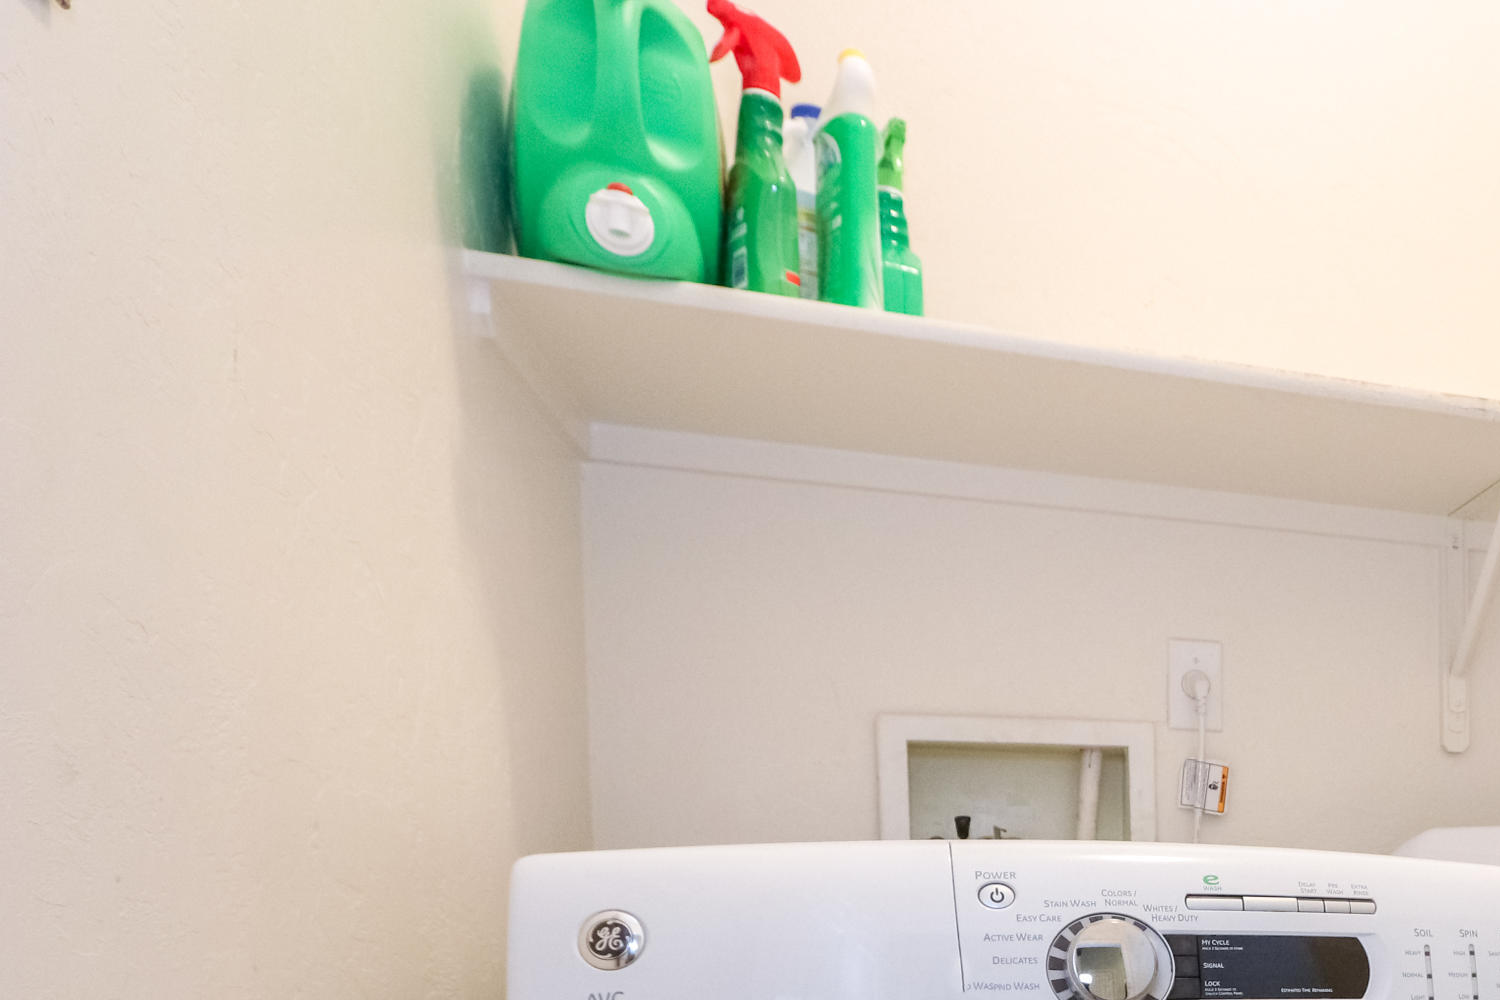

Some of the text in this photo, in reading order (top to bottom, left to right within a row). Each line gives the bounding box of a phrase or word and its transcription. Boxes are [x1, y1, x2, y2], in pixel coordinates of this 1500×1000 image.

[975, 871, 1017, 880] POWER
[1043, 899, 1097, 908] STAIN WASH
[1104, 899, 1138, 907] NORMAL
[1016, 914, 1062, 923] EASY CARE
[1151, 914, 1199, 923] HEAVY DUTY
[1414, 928, 1433, 937] SOIL
[1459, 929, 1478, 938] SPIN
[983, 933, 1044, 942] ACTIVE WEAR
[992, 956, 1038, 965] DELICATES
[1013, 982, 1040, 991] WASH
